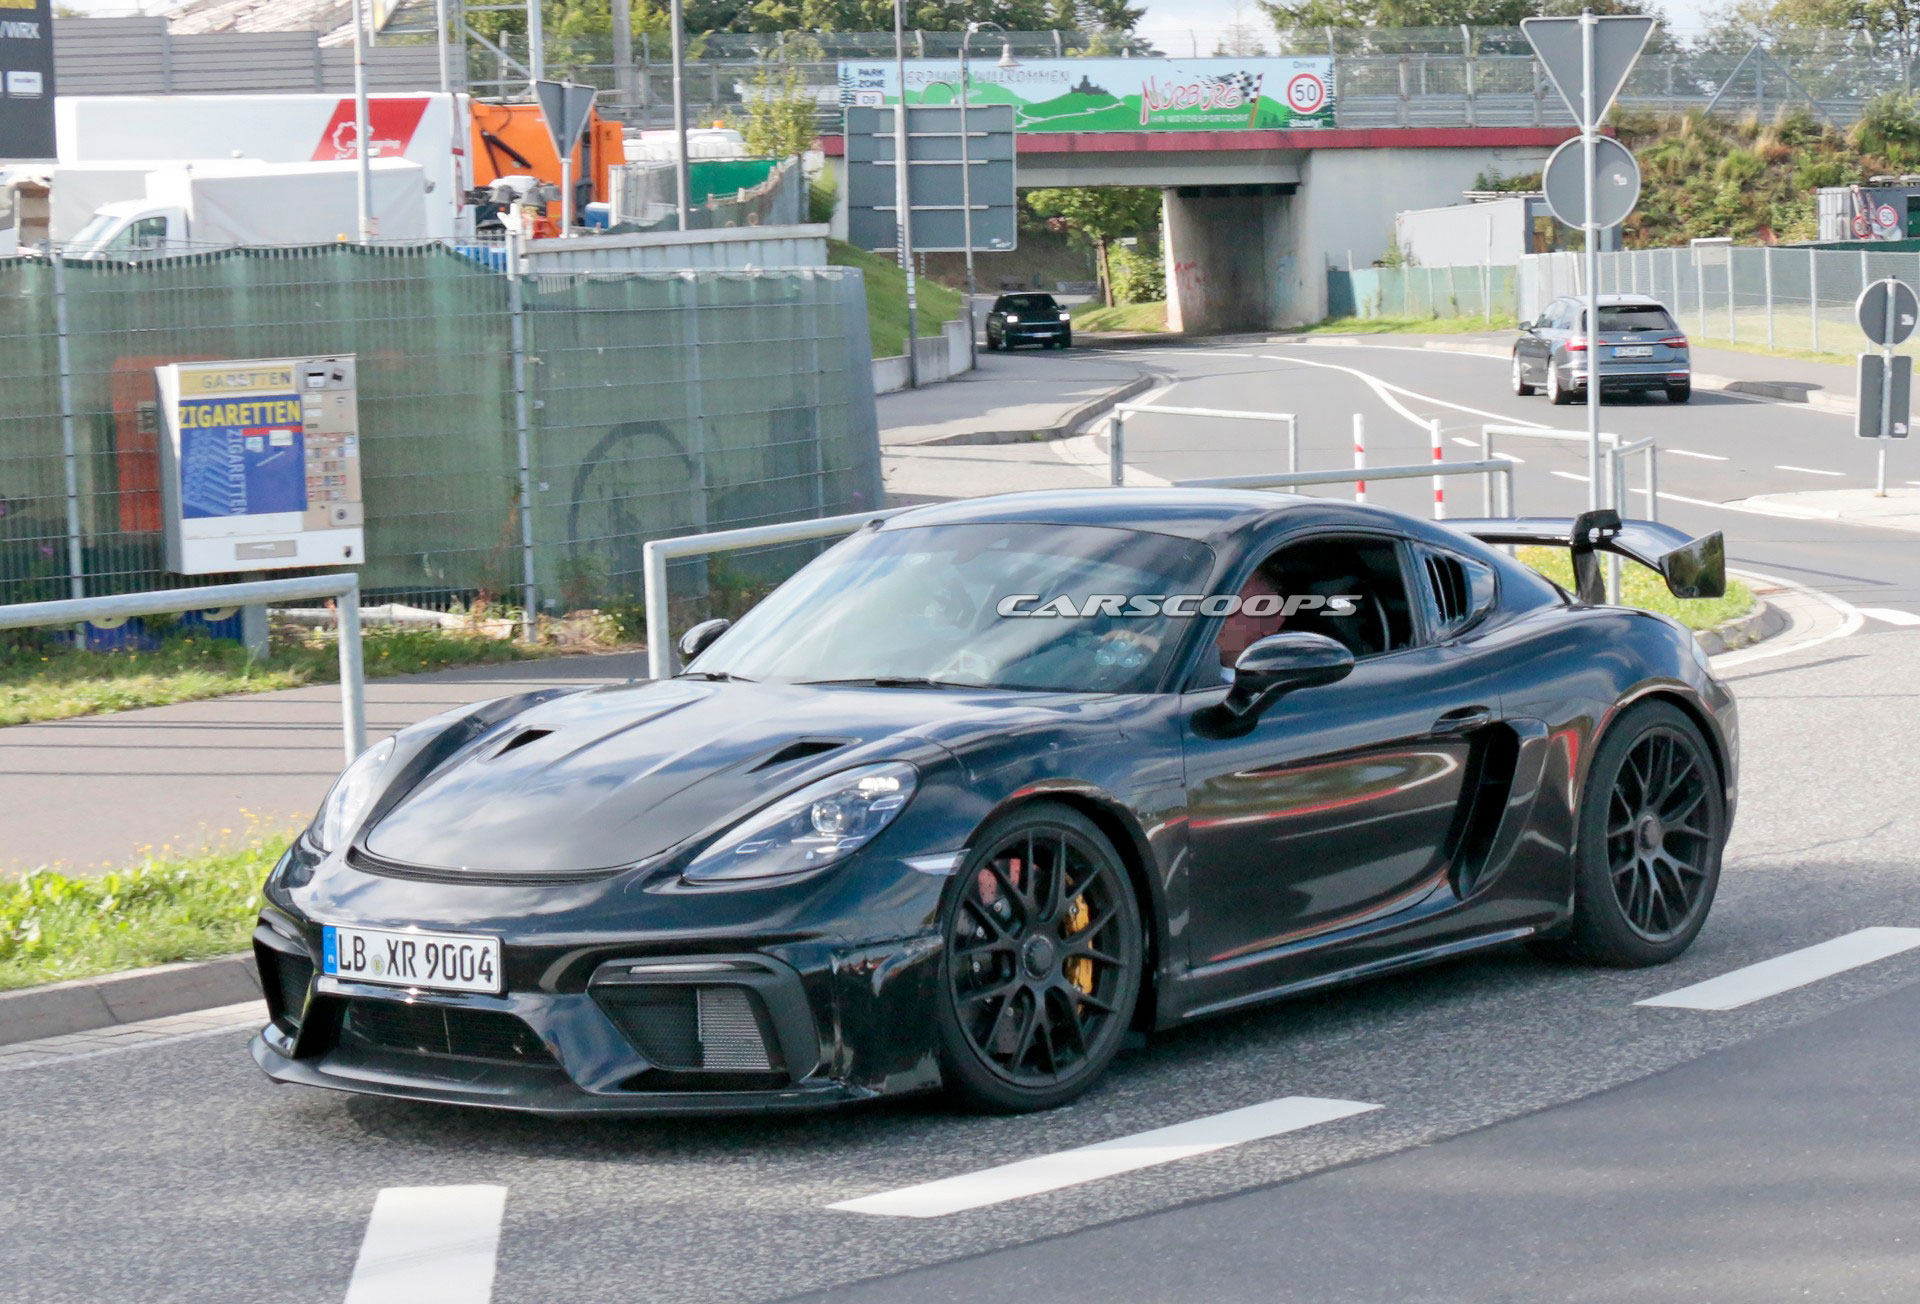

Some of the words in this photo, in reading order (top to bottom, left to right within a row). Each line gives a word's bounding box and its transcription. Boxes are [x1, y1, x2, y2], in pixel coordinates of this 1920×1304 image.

[858, 80, 885, 88] ZONE
[897, 70, 967, 84] ERZLIC
[974, 69, 1069, 84] WILLKOMMEN
[1295, 84, 1316, 102] 50
[179, 400, 301, 429] ZIGARETTEN
[226, 428, 248, 516] ZIGARETTEN
[338, 933, 367, 972] LB
[386, 938, 418, 978] XR
[425, 942, 494, 983] 9004
